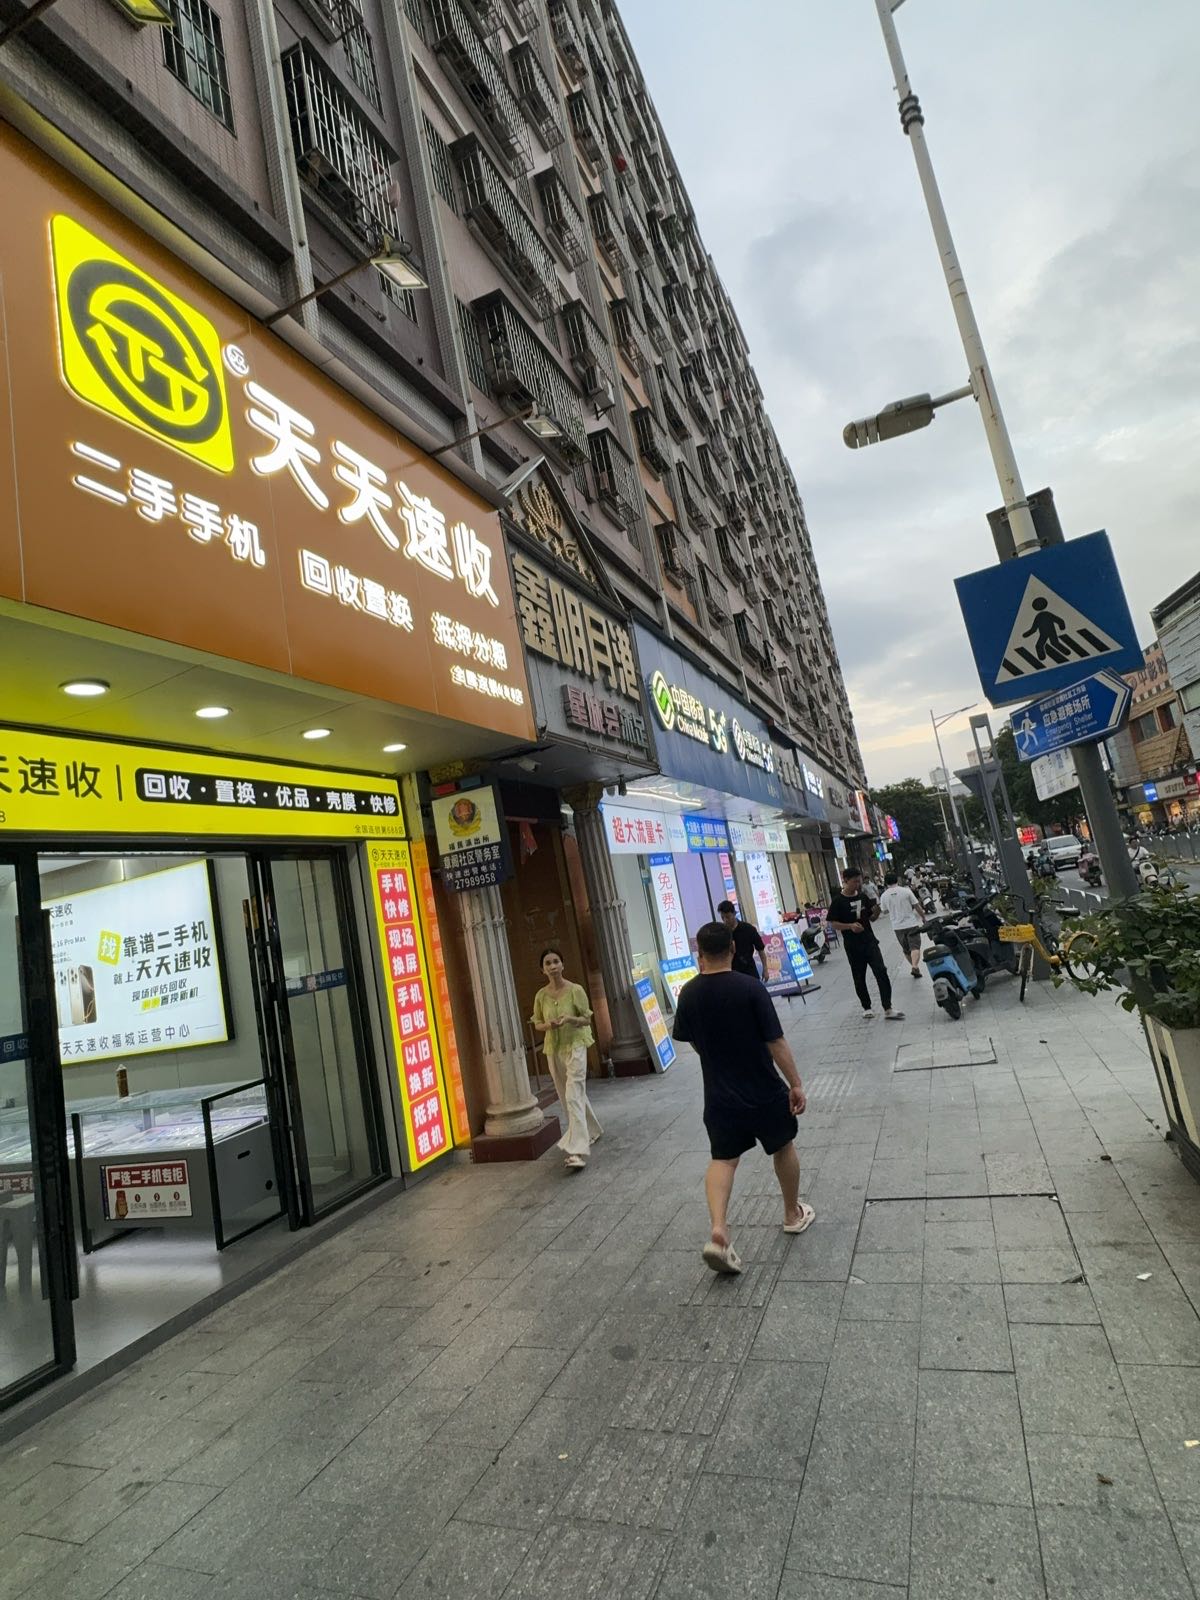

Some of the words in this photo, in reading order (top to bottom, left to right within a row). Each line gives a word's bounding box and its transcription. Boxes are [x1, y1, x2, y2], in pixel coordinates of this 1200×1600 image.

[71, 441, 266, 567] 二手手机
[244, 380, 499, 608] 天天速收
[299, 548, 414, 632] 回收置换
[512, 552, 641, 702] 鑫明月港
[671, 684, 706, 725] 中国移动
[1043, 694, 1091, 728] 应急避难场所
[611, 816, 665, 845] 超大流量卡
[443, 845, 501, 870] 章阁社区警务室
[381, 873, 407, 894] 手机
[454, 872, 496, 890] 27989958
[384, 898, 410, 919] 快修
[657, 872, 684, 955] 免费办卡
[123, 920, 209, 958] 靠谱二手机
[388, 928, 414, 949] 现场
[392, 953, 418, 976] 换屏
[132, 978, 188, 1002] 现场评估回收
[397, 984, 422, 1008] 手机
[400, 1009, 426, 1035] 回收
[62, 1023, 191, 1056] 天天速收福城运营中心
[404, 1039, 431, 1066] 以旧
[408, 1066, 434, 1095] 换新
[413, 1096, 439, 1128] 抵押
[418, 1124, 444, 1156] 租机
[111, 1167, 184, 1187] 严选二手机专柜
